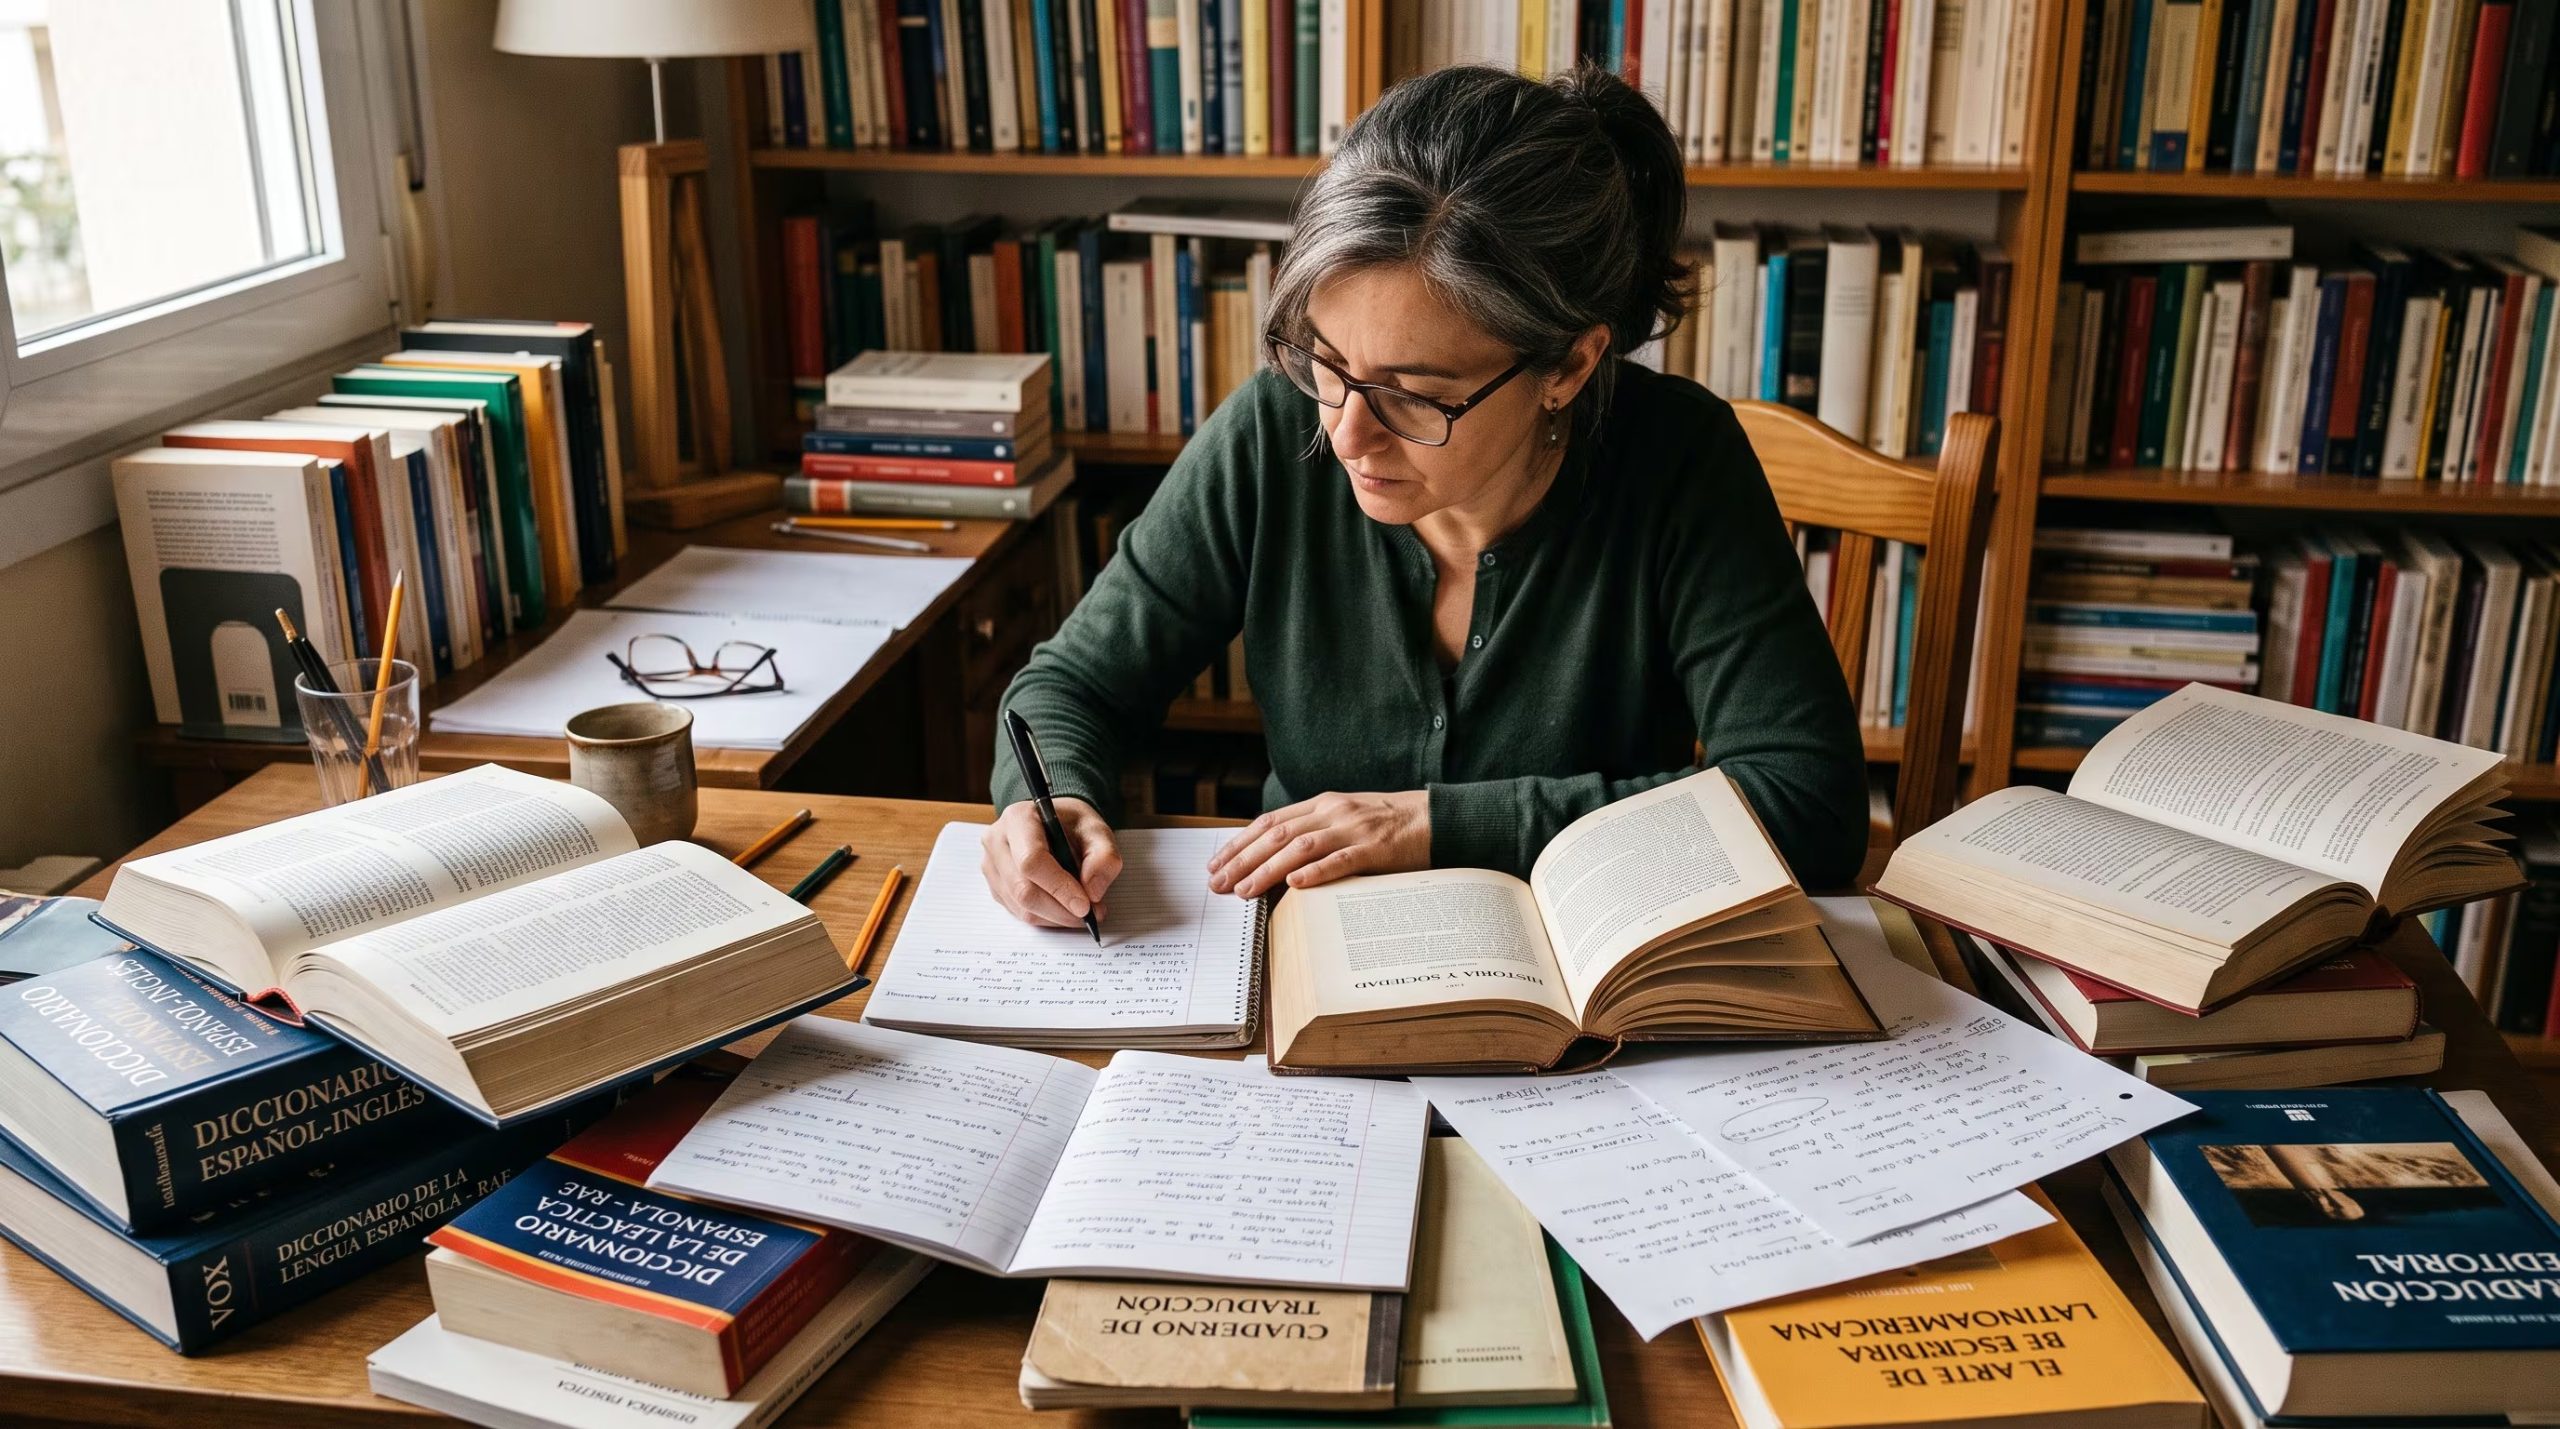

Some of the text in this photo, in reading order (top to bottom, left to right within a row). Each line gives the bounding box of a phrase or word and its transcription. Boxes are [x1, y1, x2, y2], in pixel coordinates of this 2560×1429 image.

[1354, 970, 1544, 989] HISTORIA Y SOCIEDAD
[21, 986, 168, 1087] DICCIONARIO
[200, 1081, 426, 1183] ESPAÑOL-INGLÉS
[558, 1181, 613, 1206] RAE
[277, 1168, 469, 1263] DICCIONARIO DE LA
[537, 1196, 748, 1267] DE LA LEACTICA
[280, 1239, 361, 1285] LENGUA
[366, 1193, 462, 1244] ESPAÑOLA
[514, 1214, 725, 1286] DICCIONNARIO
[2356, 1252, 2560, 1275] EDITORIAL
[202, 1255, 235, 1331] VOX
[1116, 1294, 1320, 1317] TRADUCCIÓN
[1100, 1318, 1329, 1340] CUADERNO DE
[1769, 1302, 2099, 1342] LATINOAMERICANA
[2022, 1330, 2066, 1349] BE
[1881, 1357, 2062, 1389] EL ARTE DE
